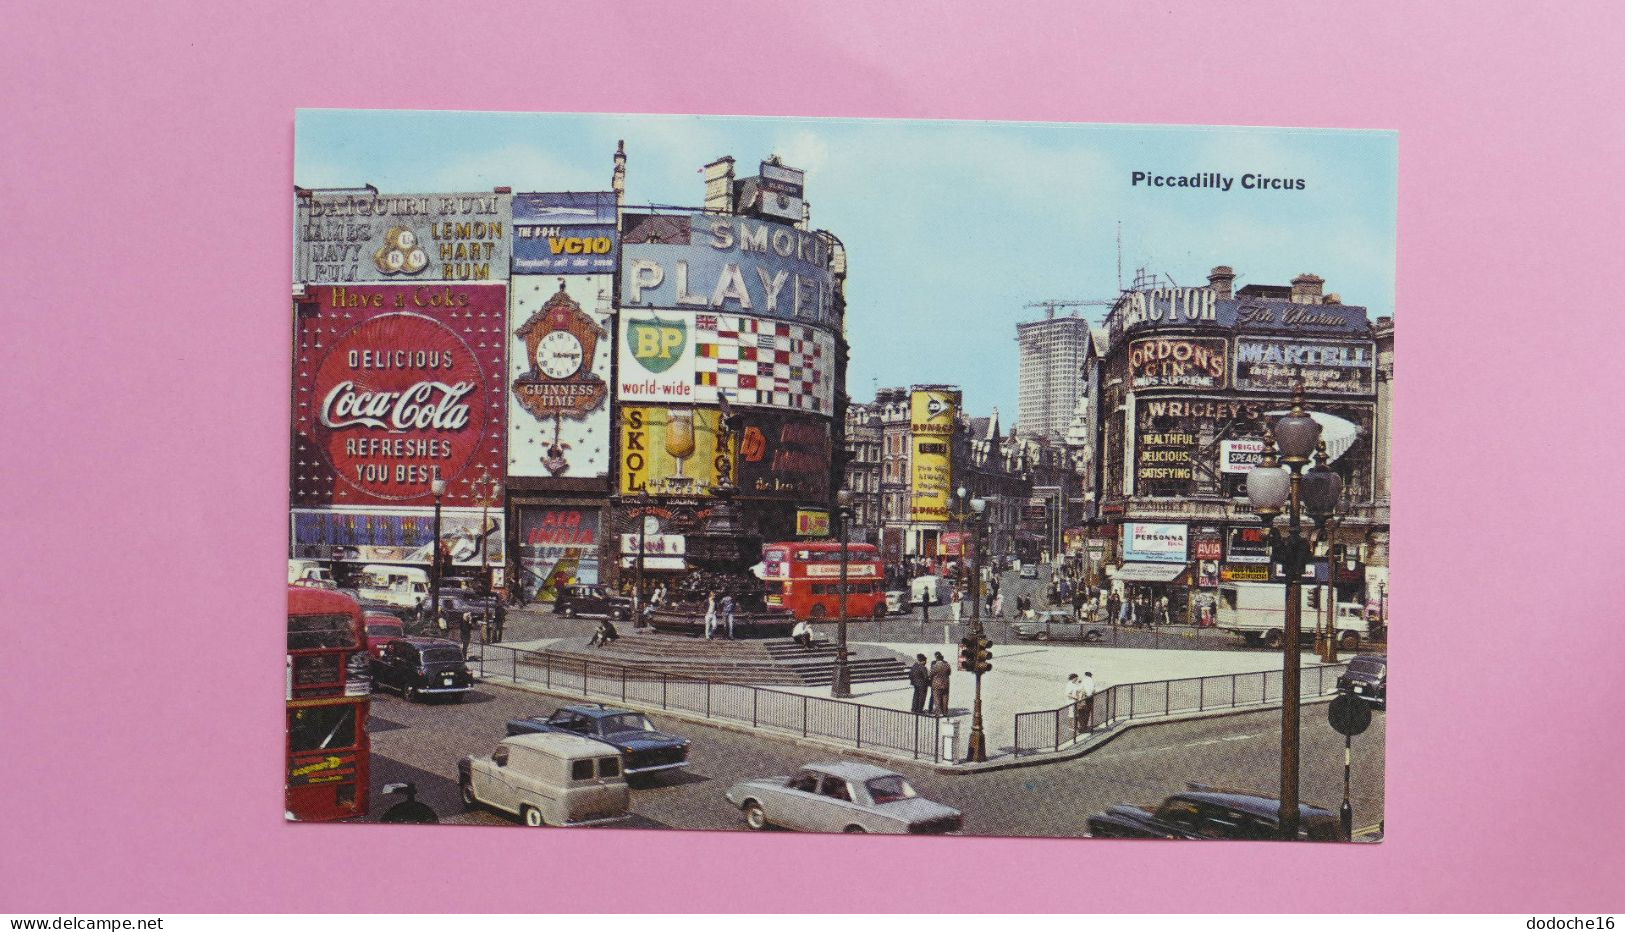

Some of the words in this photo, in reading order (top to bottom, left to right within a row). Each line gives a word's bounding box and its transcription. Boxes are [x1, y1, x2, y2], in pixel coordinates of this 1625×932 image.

[309, 197, 428, 217] DAIQUIRI
[440, 196, 499, 215] RUM
[431, 222, 503, 241] LEMON
[518, 227, 531, 238] THE
[440, 242, 494, 261] HART
[549, 236, 611, 254] VC10
[443, 263, 490, 280] RUM
[332, 287, 384, 307] Have
[395, 293, 404, 306] a
[414, 286, 470, 307] Coke
[636, 326, 683, 358] BP
[348, 350, 454, 368] DELICIOUS
[1132, 340, 1223, 378] ORDON'S
[1239, 343, 1372, 367] MARTELL
[523, 384, 594, 396] GUINNESS
[622, 375, 691, 396] world-wide
[1161, 376, 1214, 386] SUPREME
[321, 380, 476, 429] Coca-Cola
[541, 396, 577, 407] TIME
[346, 438, 452, 457] REFRESHES
[626, 411, 647, 492] SKOL
[1231, 443, 1263, 451] WRIGLE
[356, 465, 389, 481] YOU
[396, 465, 442, 482] BEST
[1140, 468, 1190, 479] SATISFYING
[543, 511, 581, 527] AIR
[528, 527, 594, 545] INDIA
[1198, 543, 1221, 554] AVIA
